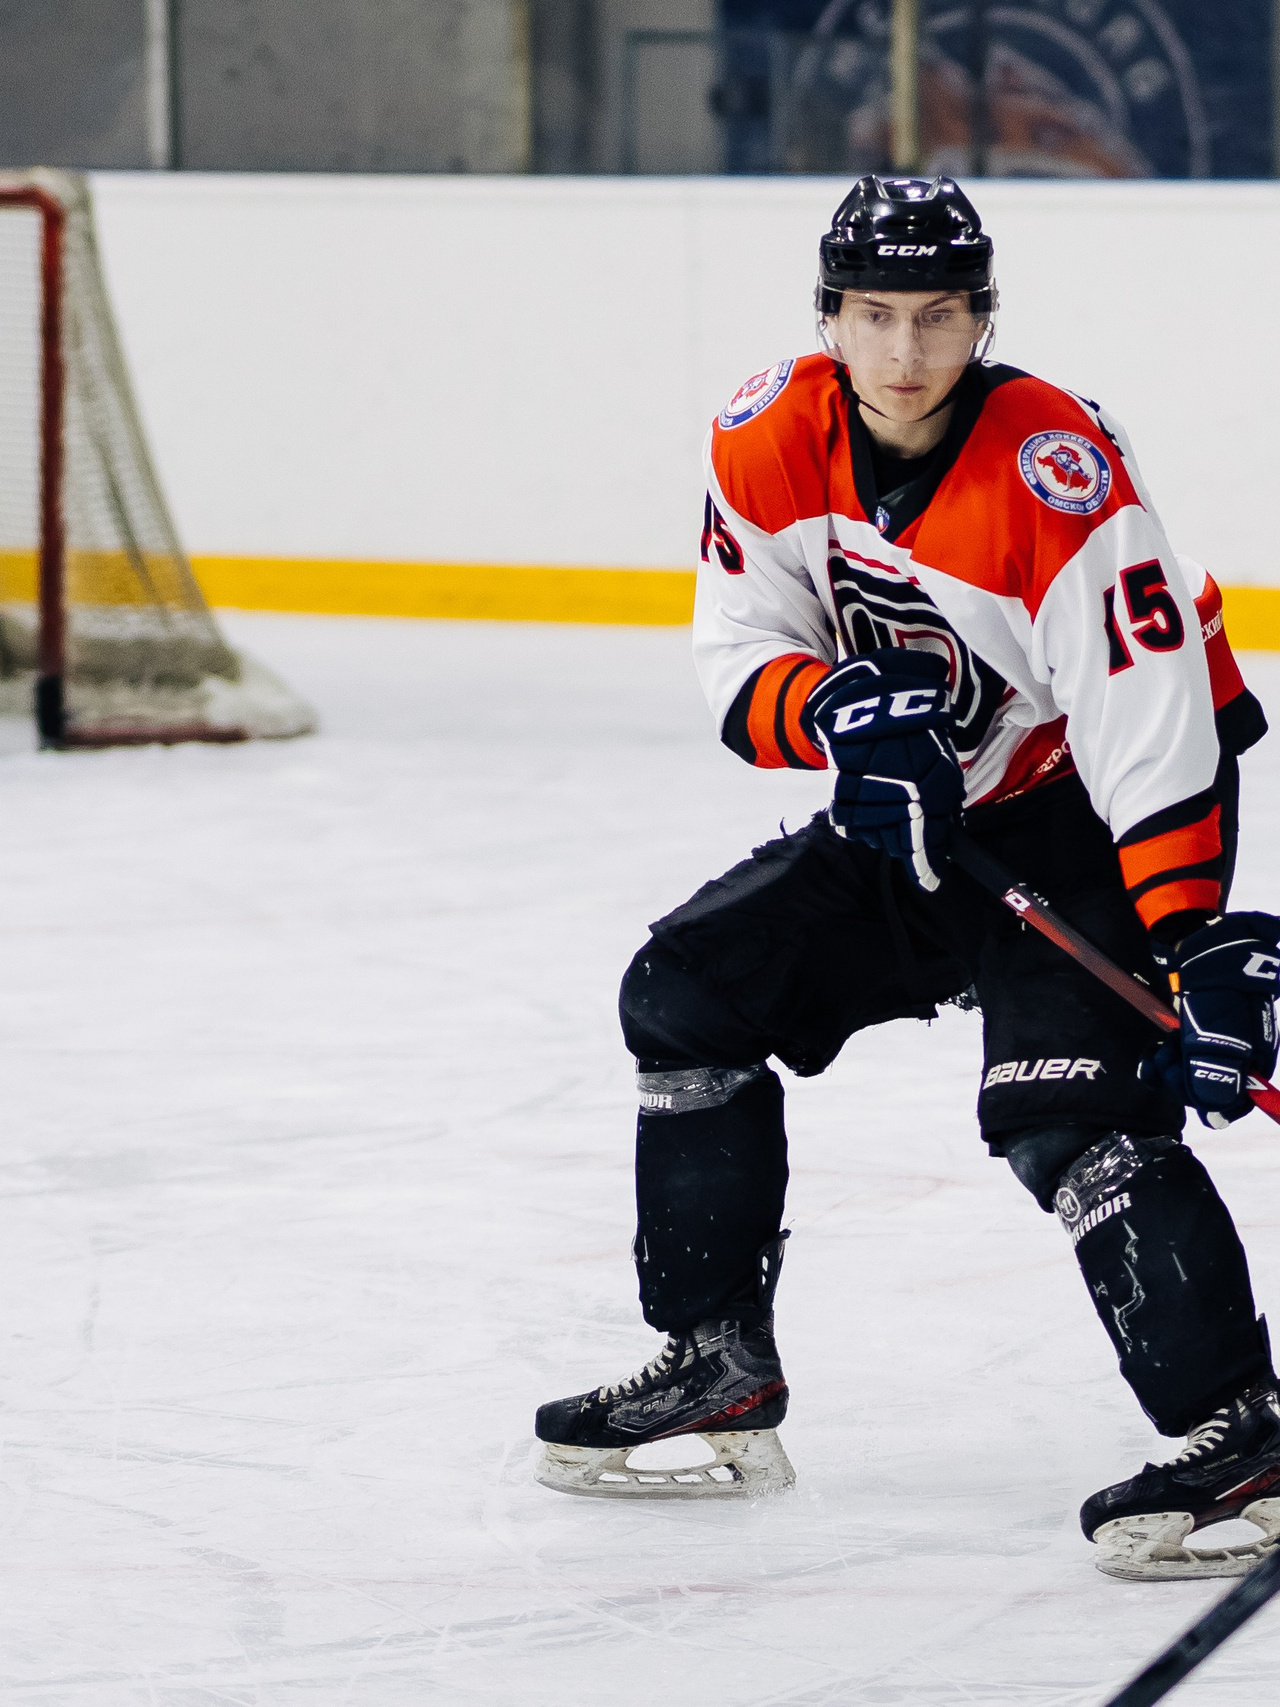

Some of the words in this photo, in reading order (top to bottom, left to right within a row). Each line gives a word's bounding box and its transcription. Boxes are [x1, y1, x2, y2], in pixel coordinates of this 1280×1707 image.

[877, 245, 938, 257] CCM
[1047, 433, 1092, 449] ХОККЕЯ
[1102, 557, 1185, 677] 15
[833, 689, 951, 734] CC
[1194, 1069, 1236, 1084] CCM
